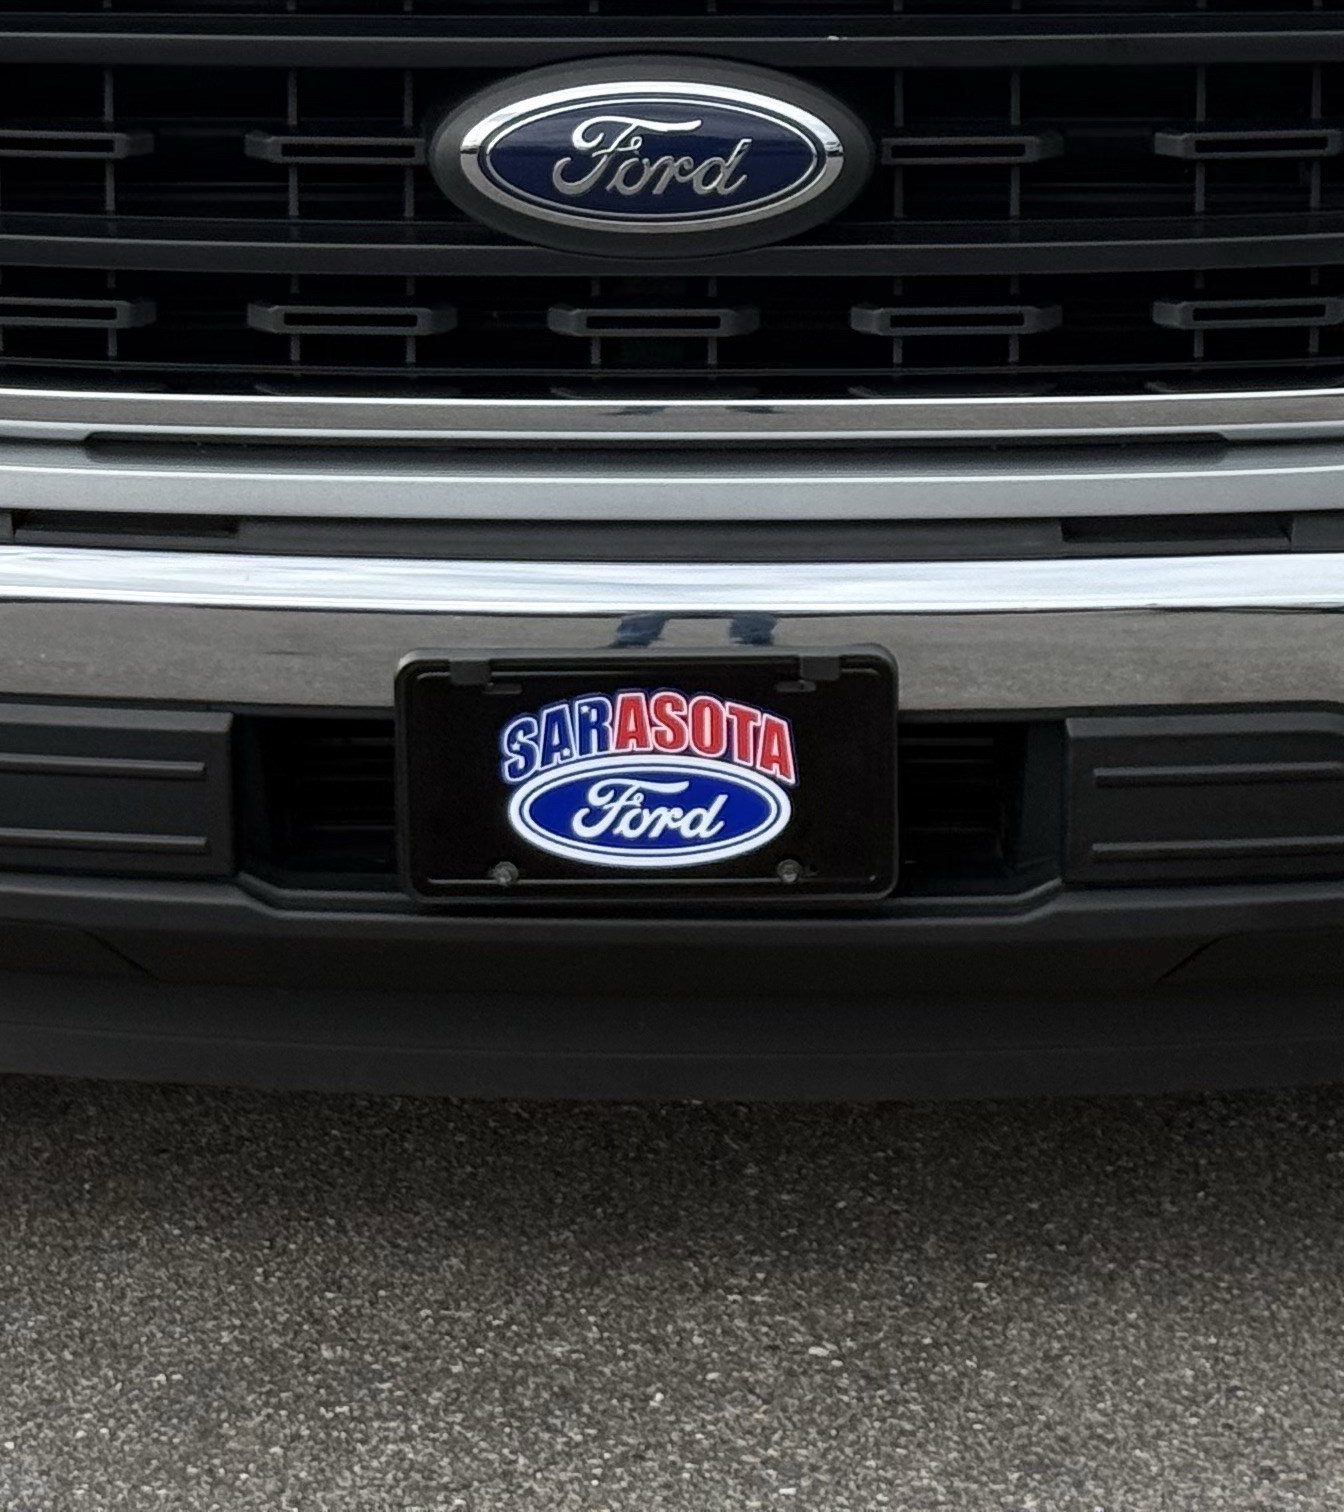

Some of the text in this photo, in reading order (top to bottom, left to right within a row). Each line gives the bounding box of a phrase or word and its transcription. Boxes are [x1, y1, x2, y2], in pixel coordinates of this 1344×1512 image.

[552, 114, 753, 196] Ford
[501, 690, 798, 786] SARASOTA
[571, 777, 729, 839] Ford
